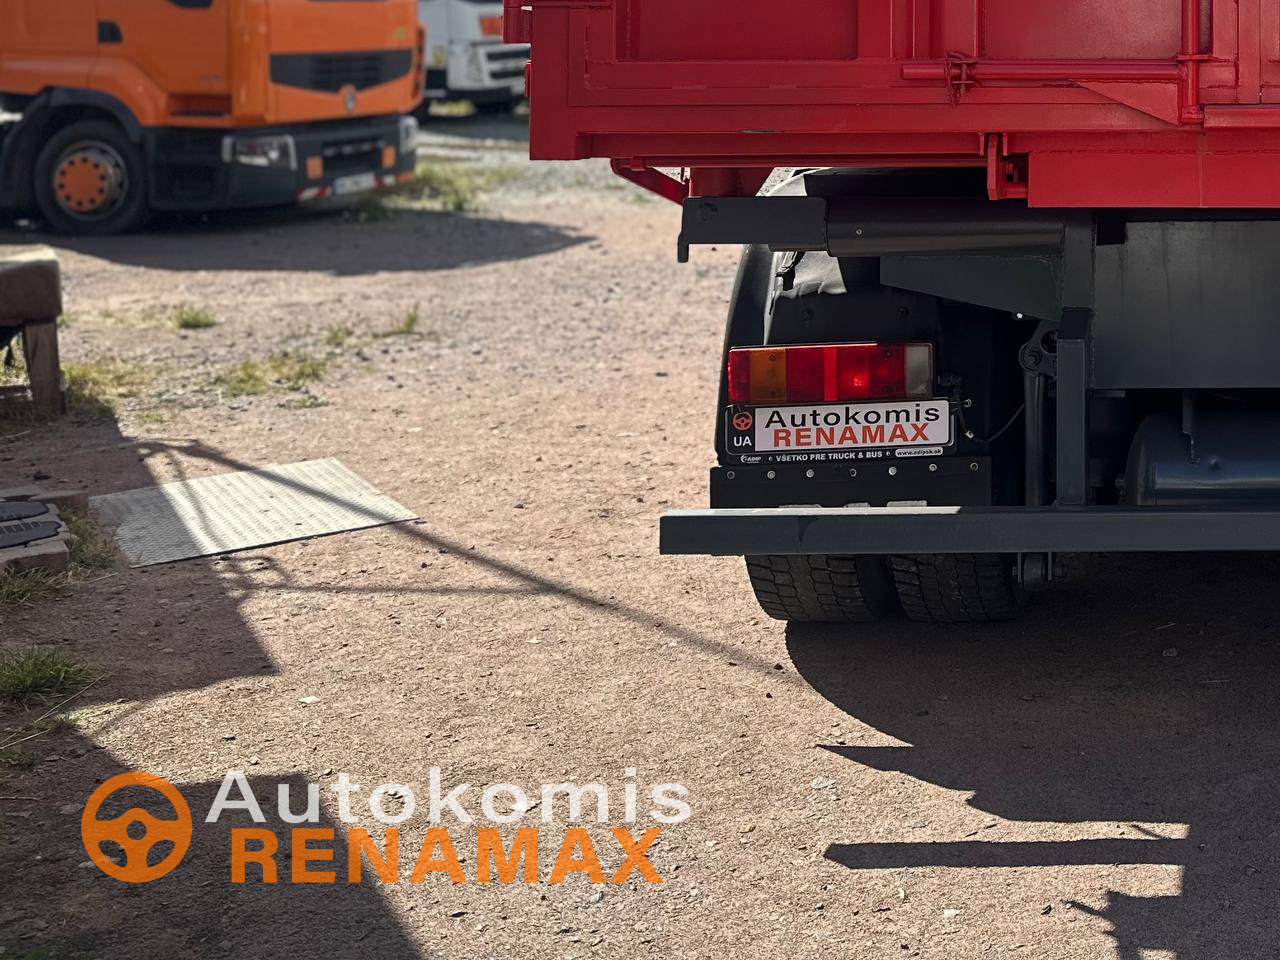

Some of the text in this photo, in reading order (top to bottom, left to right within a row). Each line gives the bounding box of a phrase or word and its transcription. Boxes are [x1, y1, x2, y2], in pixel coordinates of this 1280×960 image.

[765, 403, 940, 429] Autokomis
[733, 436, 752, 447] UA
[773, 422, 930, 448] RENAMAX
[776, 450, 883, 462] VŠETKO PRE TRUCK & BUS
